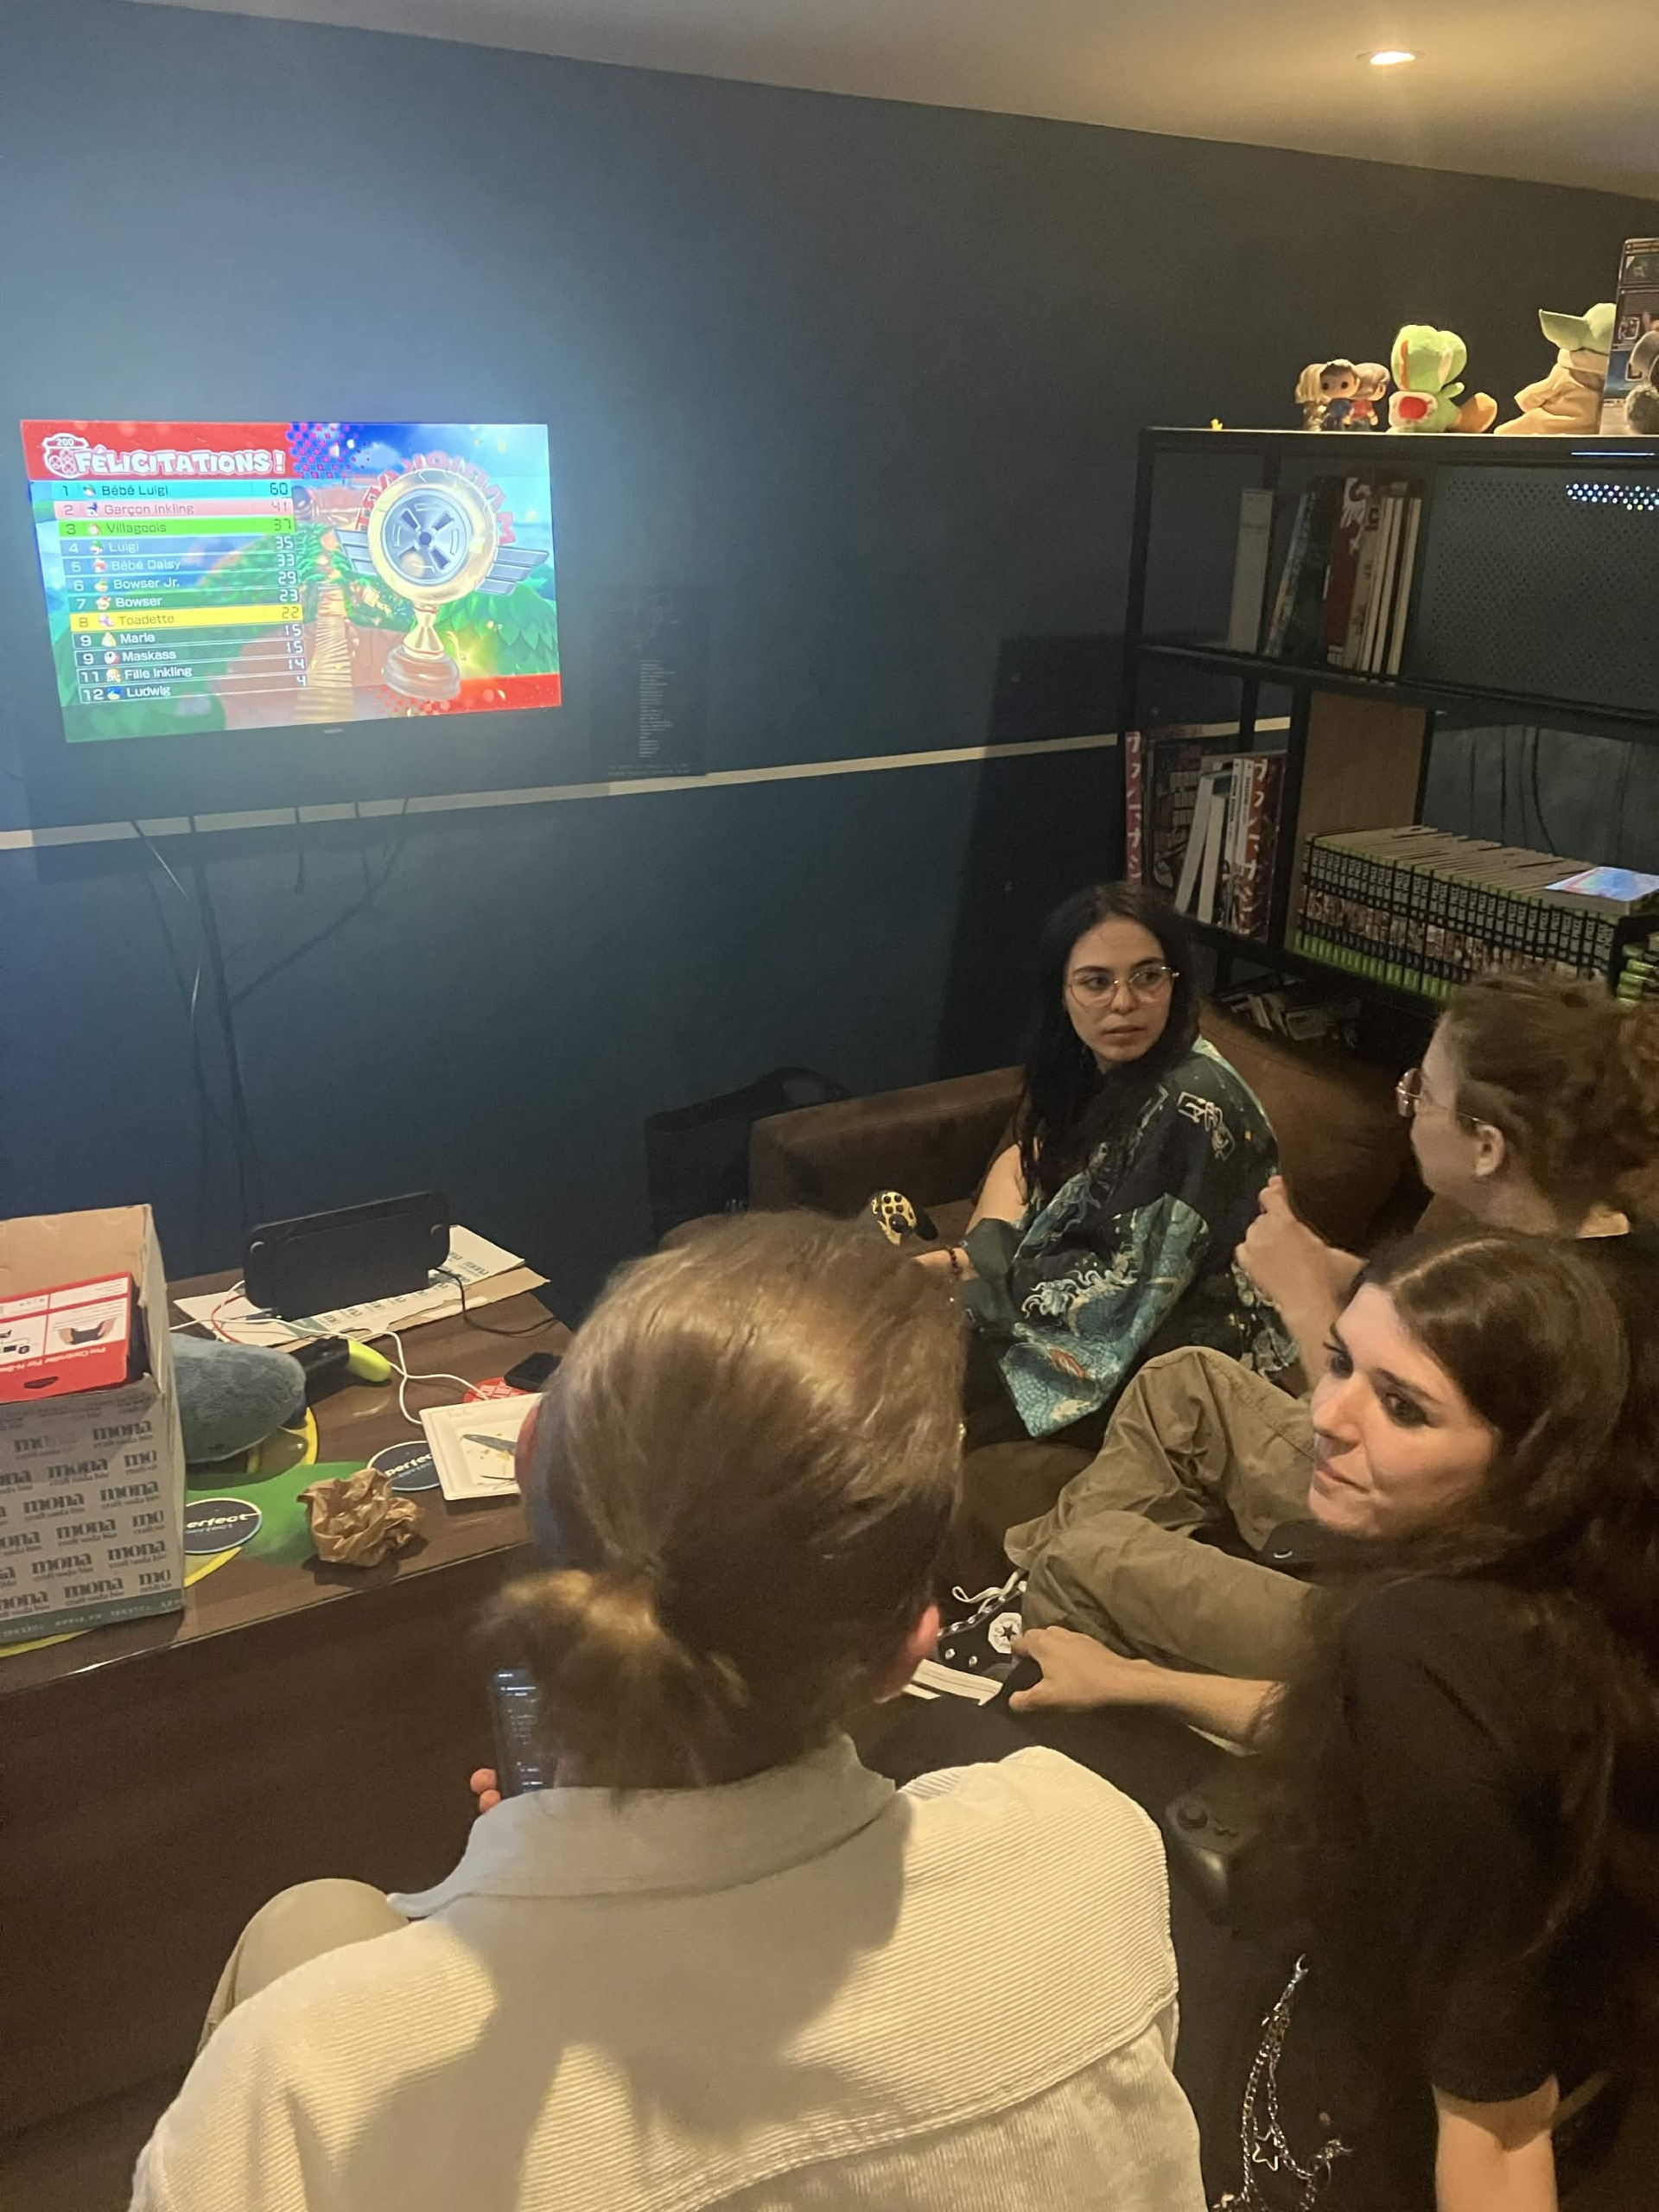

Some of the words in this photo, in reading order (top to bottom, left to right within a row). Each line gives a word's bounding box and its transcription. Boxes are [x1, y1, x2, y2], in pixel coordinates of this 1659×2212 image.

[57, 438, 74, 447] 200
[61, 486, 69, 496] 1
[102, 485, 134, 496] Bébé
[138, 485, 169, 497] Luigi
[270, 482, 289, 495] 60
[63, 505, 74, 516] 2
[104, 504, 151, 517] Garçon
[154, 503, 194, 515] Inkling
[270, 500, 288, 512] 41
[66, 524, 77, 535] 3
[106, 523, 168, 535] Villageois
[273, 518, 292, 531] 37
[68, 543, 79, 554] 4
[109, 542, 140, 553] Luigi
[276, 537, 294, 550] 35
[71, 562, 81, 572] 5
[147, 559, 182, 571] Daisy
[277, 555, 296, 567] 33
[73, 580, 85, 591] 6
[113, 578, 161, 590] Bowser
[278, 571, 297, 584] 29
[76, 599, 86, 609] 7
[116, 596, 162, 607] Bowser
[279, 589, 298, 602] 23
[79, 617, 89, 628] 8
[118, 614, 175, 626] Toadette
[282, 607, 300, 620] 22
[80, 635, 92, 646] 9
[284, 624, 302, 636] 15
[83, 653, 94, 664] 9
[123, 651, 176, 662] Maskass
[287, 641, 303, 653] 15
[81, 671, 99, 683] 11
[124, 668, 150, 680] Fille
[153, 666, 193, 679] Inkling
[288, 658, 305, 671] 14
[83, 689, 105, 701] 12
[126, 685, 172, 698] Ludwig
[296, 675, 307, 687] 4
[56, 1518, 117, 1539] mona
[185, 1513, 249, 1529] erfect
[107, 1540, 166, 1561] mona
[31, 1553, 92, 1575] mona
[64, 1577, 124, 1599] mona
